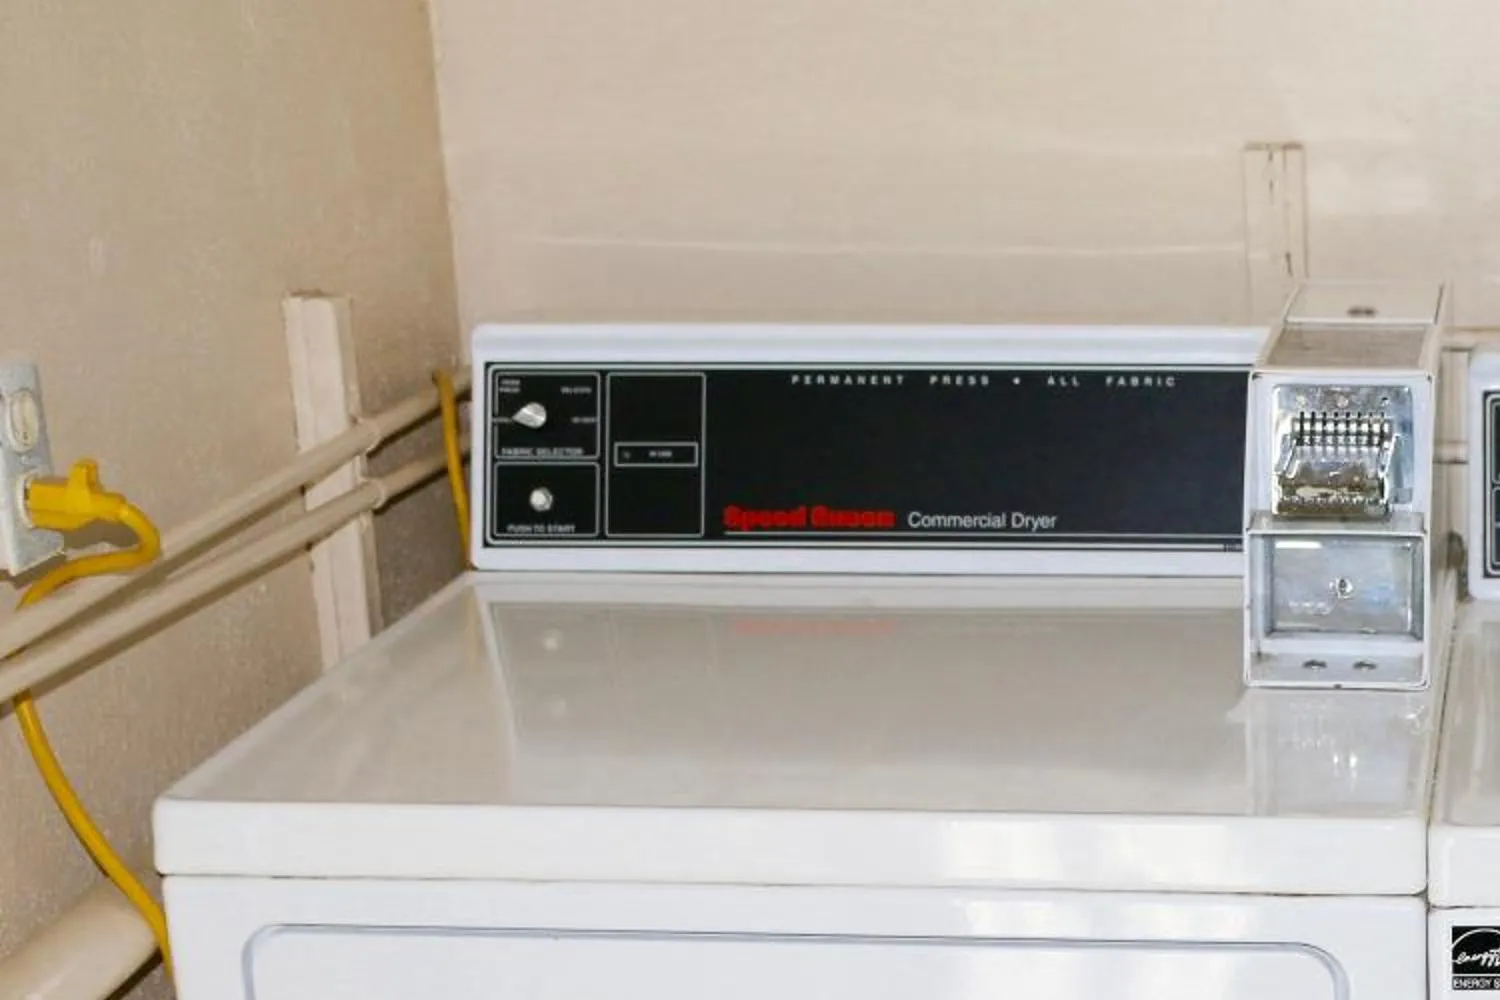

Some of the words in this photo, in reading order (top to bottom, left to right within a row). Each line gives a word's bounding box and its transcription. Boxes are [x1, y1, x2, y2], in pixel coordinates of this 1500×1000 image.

[791, 375, 905, 386] PERMANENT
[929, 375, 990, 386] PRESS
[1047, 375, 1081, 387] ALL
[1105, 376, 1177, 387] FABRIC
[907, 510, 1006, 529] Commercial
[1010, 511, 1057, 533] Dryer
[1452, 977, 1492, 989] ENERGY
